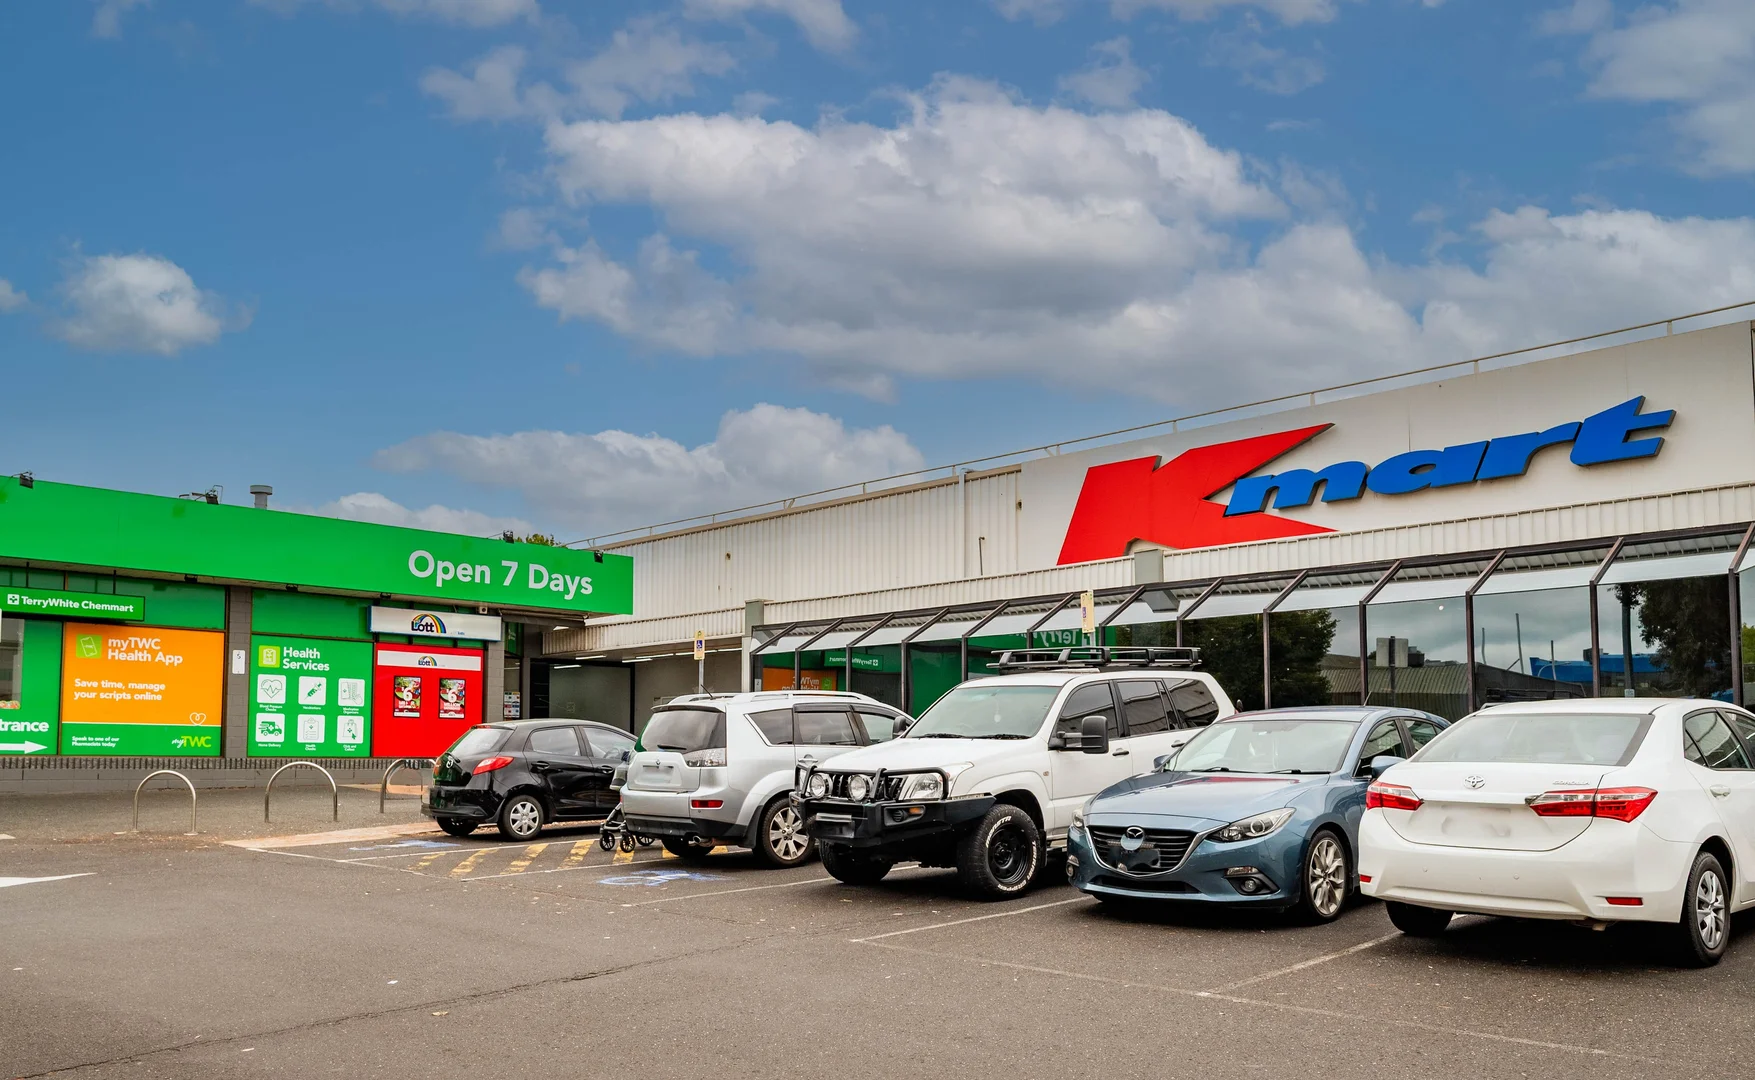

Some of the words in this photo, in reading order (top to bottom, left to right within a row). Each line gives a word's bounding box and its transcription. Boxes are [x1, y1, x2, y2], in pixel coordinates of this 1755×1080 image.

[1057, 395, 1677, 565] Kmart
[408, 550, 491, 587] Open
[501, 560, 518, 586] 7
[528, 563, 593, 600] Days
[21, 596, 79, 608] TerryWhite
[81, 601, 134, 612] Chemmart
[108, 637, 161, 651] myTWC
[108, 649, 151, 662] Health
[155, 652, 183, 666] App
[283, 646, 320, 660] Health
[283, 658, 330, 672] Services
[74, 678, 98, 688] Save
[101, 680, 125, 690] time,
[128, 682, 166, 692] manage
[74, 691, 97, 700] your
[99, 691, 131, 701] scripts
[134, 692, 162, 701] online
